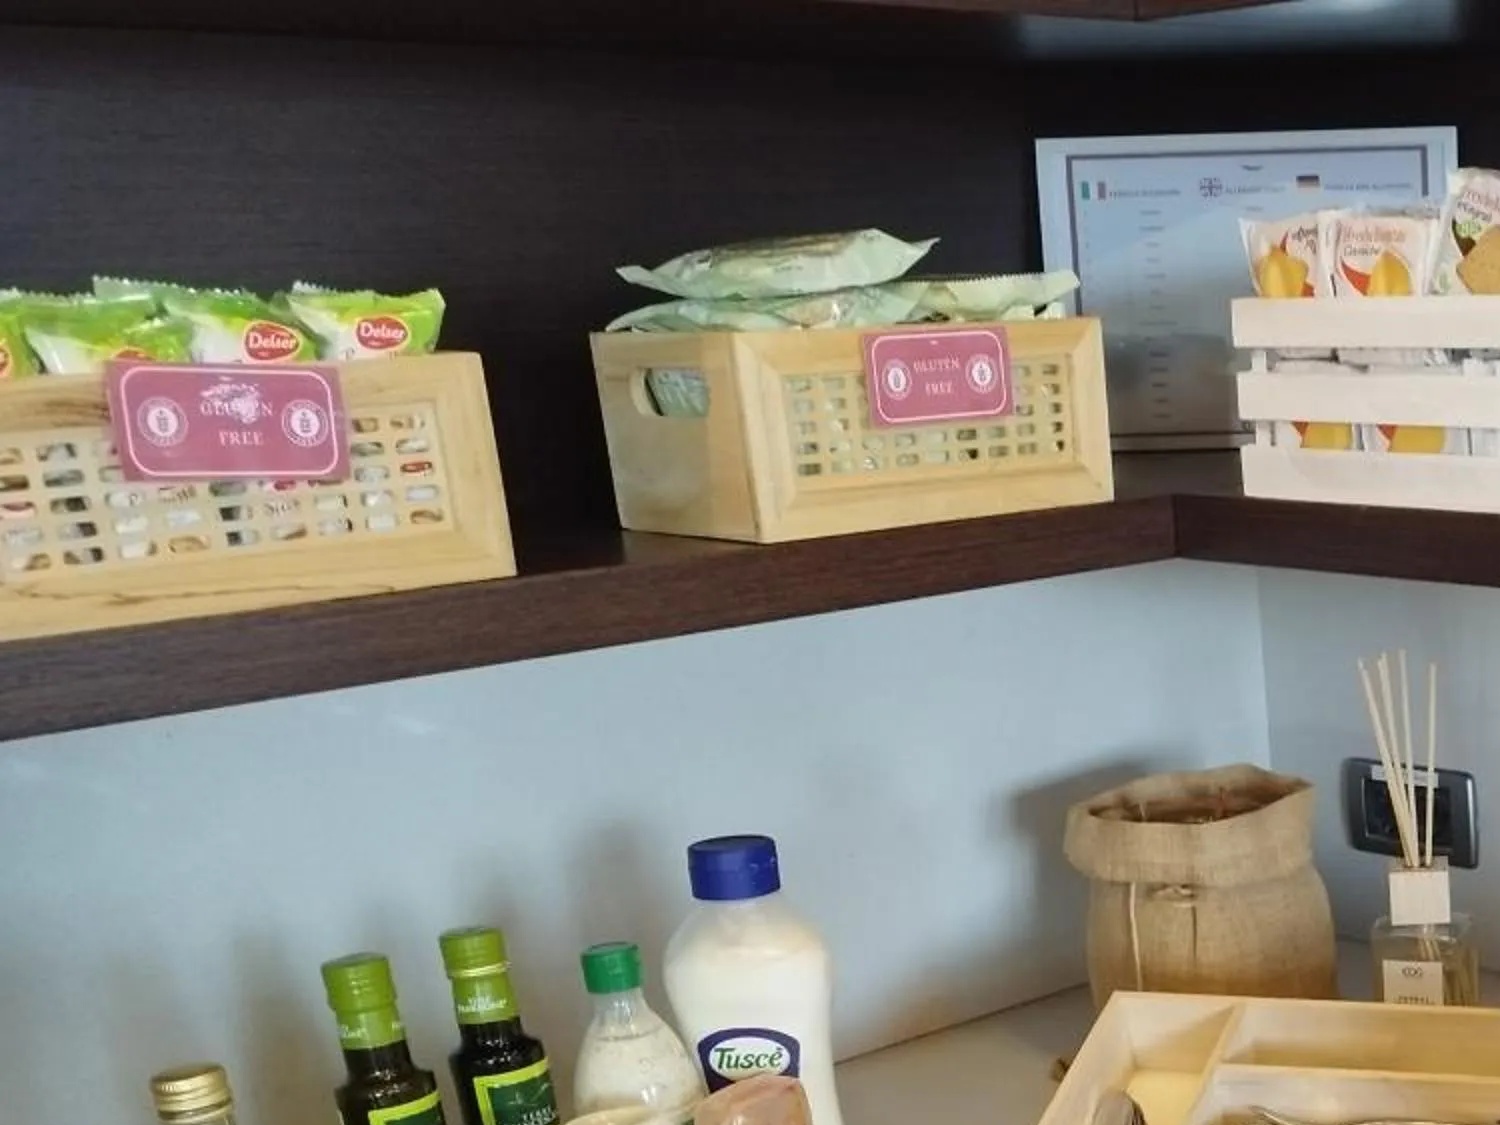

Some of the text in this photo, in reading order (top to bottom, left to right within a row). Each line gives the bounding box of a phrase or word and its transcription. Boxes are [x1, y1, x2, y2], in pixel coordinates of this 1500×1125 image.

[249, 331, 297, 349] Delser
[360, 322, 405, 340] Delser
[219, 430, 265, 446] FREE
